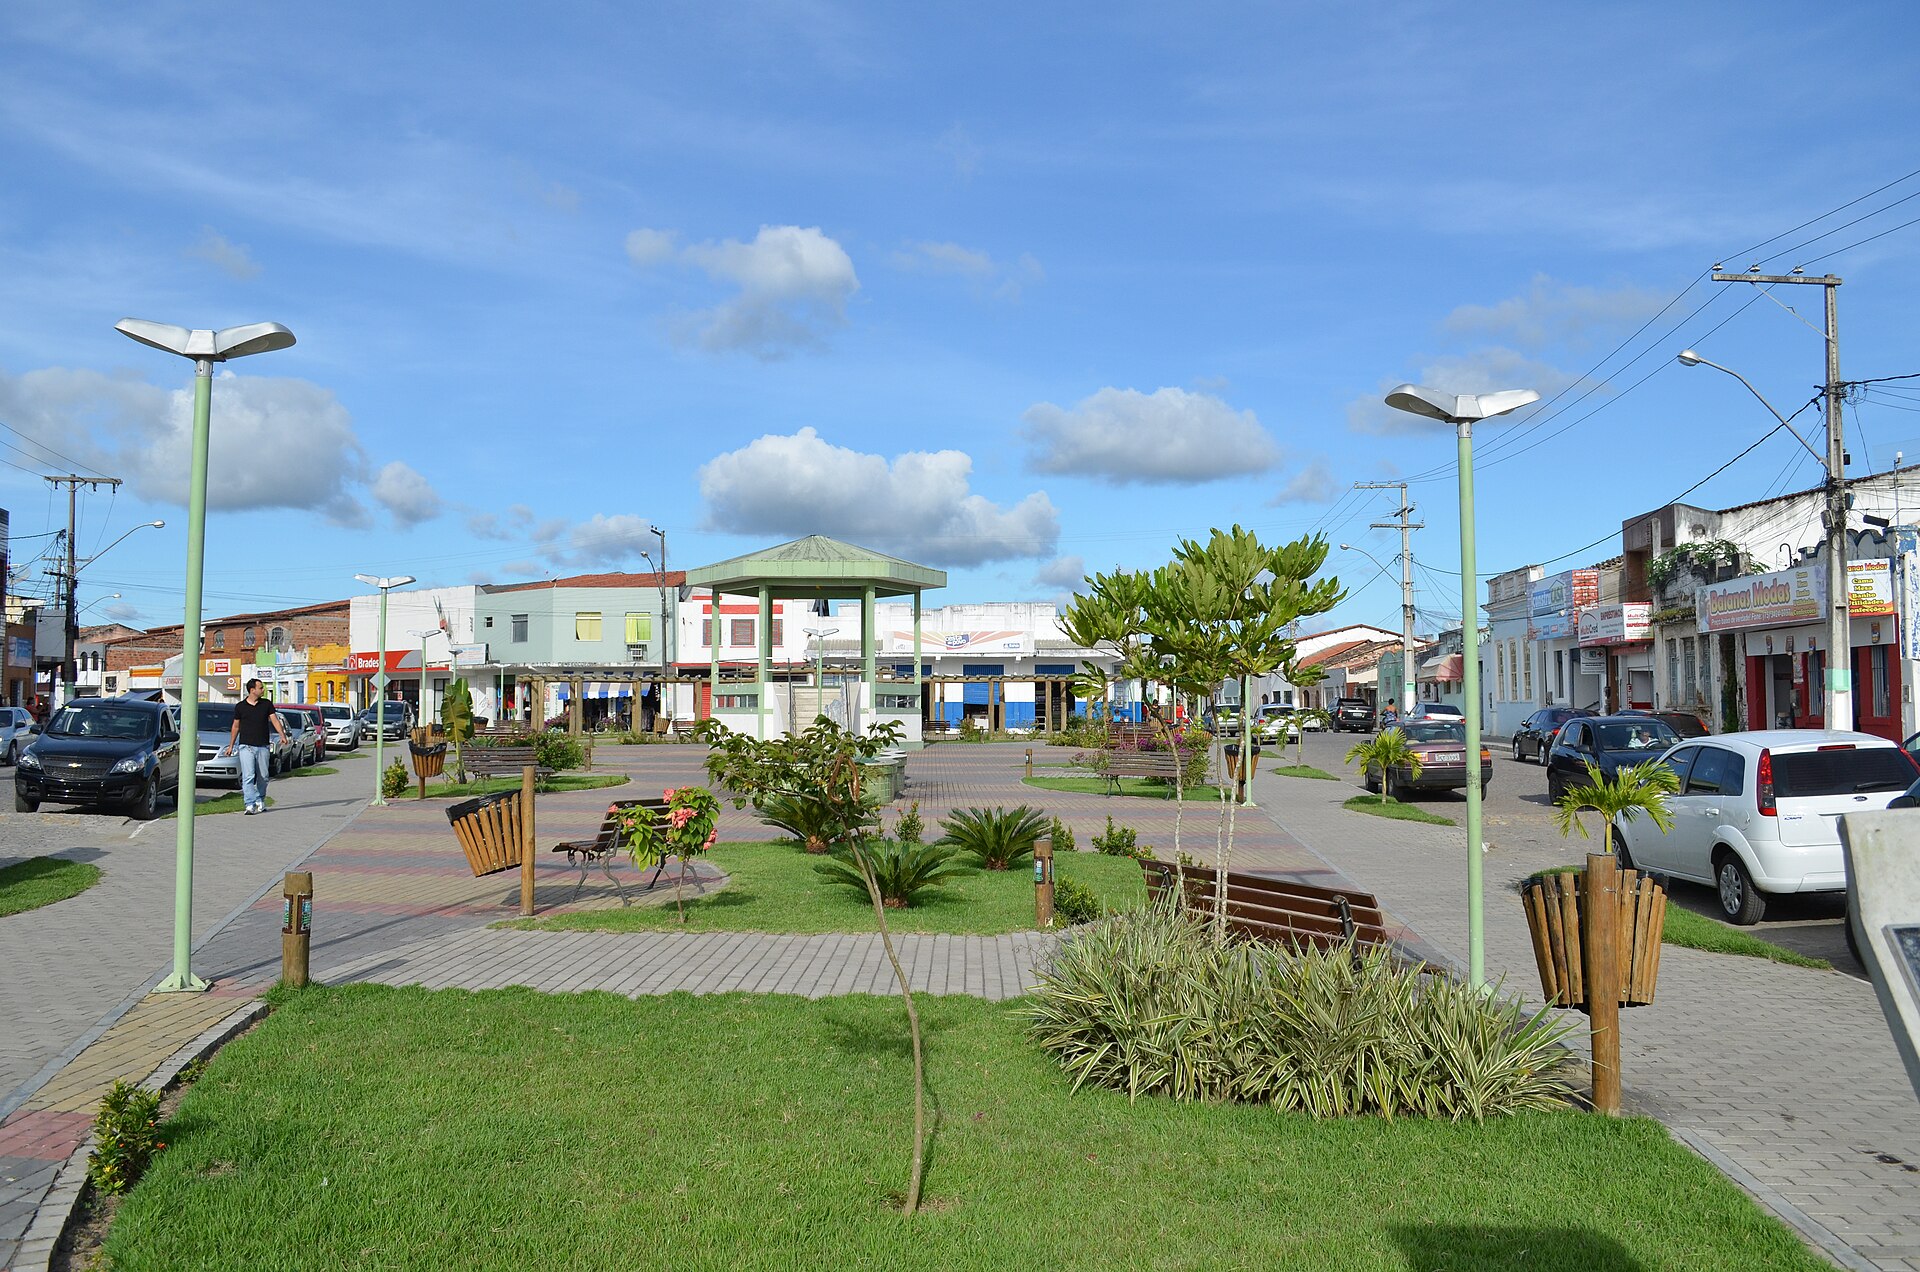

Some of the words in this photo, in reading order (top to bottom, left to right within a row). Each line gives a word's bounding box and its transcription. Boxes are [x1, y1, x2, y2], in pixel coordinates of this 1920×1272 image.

[1865, 562, 1888, 571] Modas
[1796, 571, 1809, 579] Cama
[1710, 589, 1751, 614] Baianas
[1752, 578, 1791, 607] Modas
[358, 657, 387, 668] Bradeso
